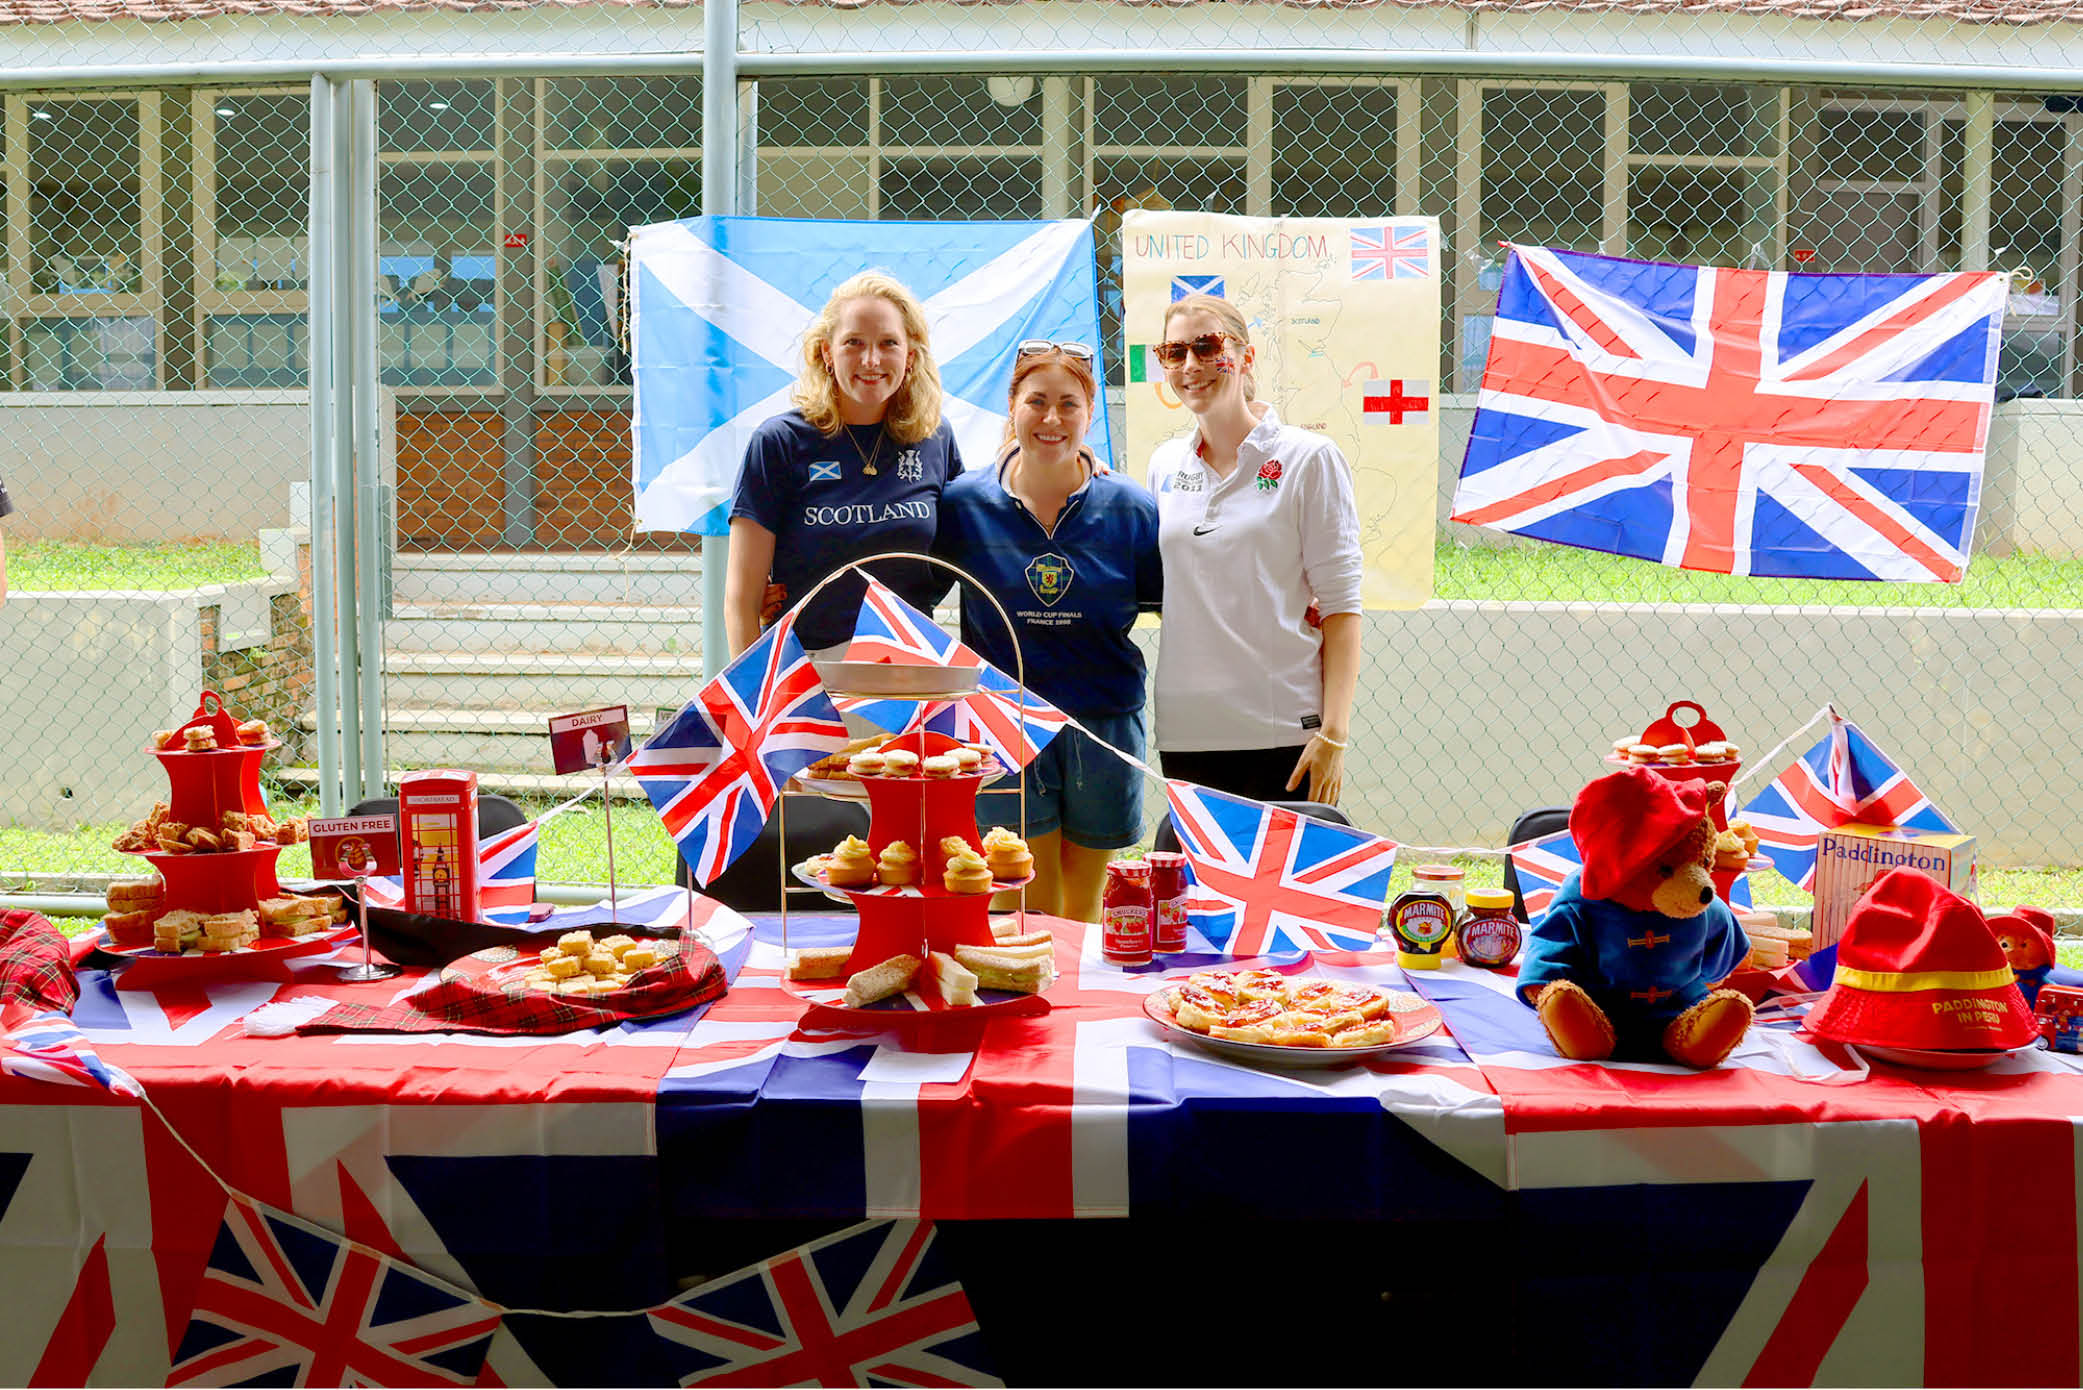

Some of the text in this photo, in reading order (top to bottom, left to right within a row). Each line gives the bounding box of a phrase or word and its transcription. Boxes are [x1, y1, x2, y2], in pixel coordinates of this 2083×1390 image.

[1136, 233, 1328, 260] UNITED KINGDOM
[1176, 470, 1204, 481] RUGBY
[1173, 482, 1202, 492] 2011
[803, 500, 930, 526] SCOTLAND
[1016, 610, 1082, 619] WORLD CUP FINALS
[1026, 618, 1054, 626] FRANCE
[571, 714, 602, 728] DAIRY
[313, 820, 391, 833] GLUTEN FREE
[1822, 837, 1945, 872] Paddington
[1403, 902, 1446, 920] MARMITE
[1471, 921, 1514, 937] MARMITE
[1932, 998, 2008, 1014] PADDINGTON
[1957, 1011, 2000, 1024] IN PERU
